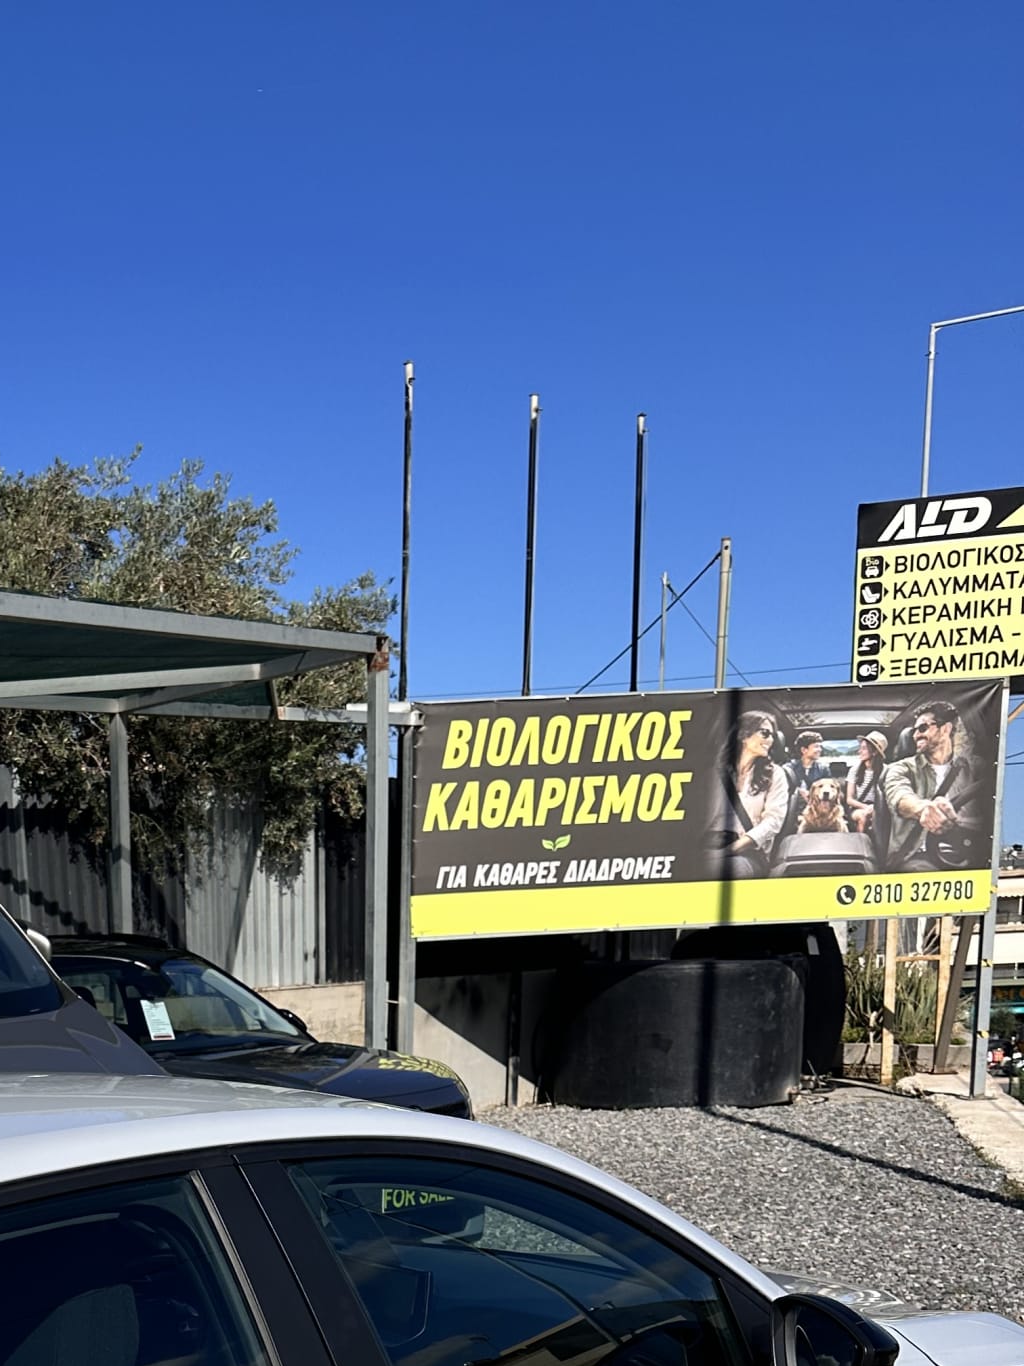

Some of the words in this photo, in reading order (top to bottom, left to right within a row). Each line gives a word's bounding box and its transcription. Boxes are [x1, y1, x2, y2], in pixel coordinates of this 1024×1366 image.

[877, 496, 992, 542] ALD
[891, 597, 1012, 626] ΚΕΡΑΜΙΚΗ
[890, 625, 1004, 652] ΓΥΑΛΙΣΜΑ
[442, 710, 692, 769] ΒΙΟΛΟΓΙΚΟΣ
[422, 772, 693, 832] ΚΑΘΑΡΙΣΜΟΣ
[436, 865, 467, 889] ΓΙΑ
[473, 861, 561, 887] ΚΑΘΑΡΕΣ
[563, 856, 675, 883] ΔΙΑΔΡΟΜΕΣ
[862, 883, 903, 904] 2810
[910, 879, 974, 902] 327980
[384, 1188, 416, 1209] FOR
